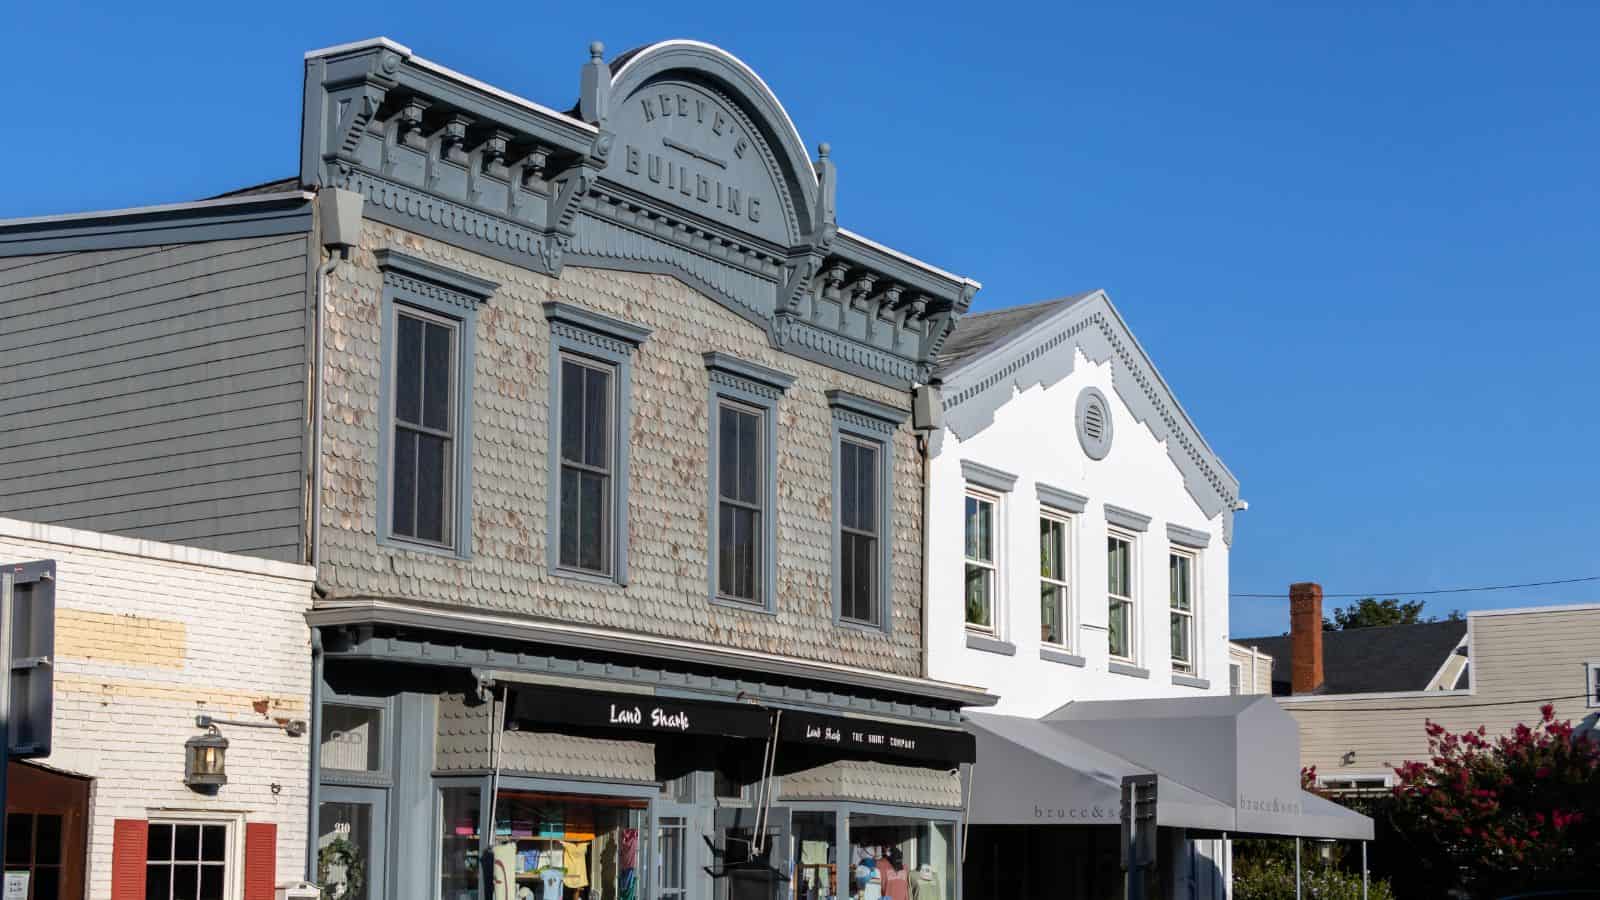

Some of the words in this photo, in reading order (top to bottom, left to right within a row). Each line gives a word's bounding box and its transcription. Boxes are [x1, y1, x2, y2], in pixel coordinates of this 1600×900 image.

[626, 145, 761, 222] BUILDING
[610, 704, 641, 724] Land
[651, 708, 689, 731] Shark
[806, 725, 821, 738] Land
[825, 728, 840, 743] Shark
[852, 732, 863, 742] THE
[868, 735, 884, 744] SHIRT
[890, 737, 915, 750] COMPANY
